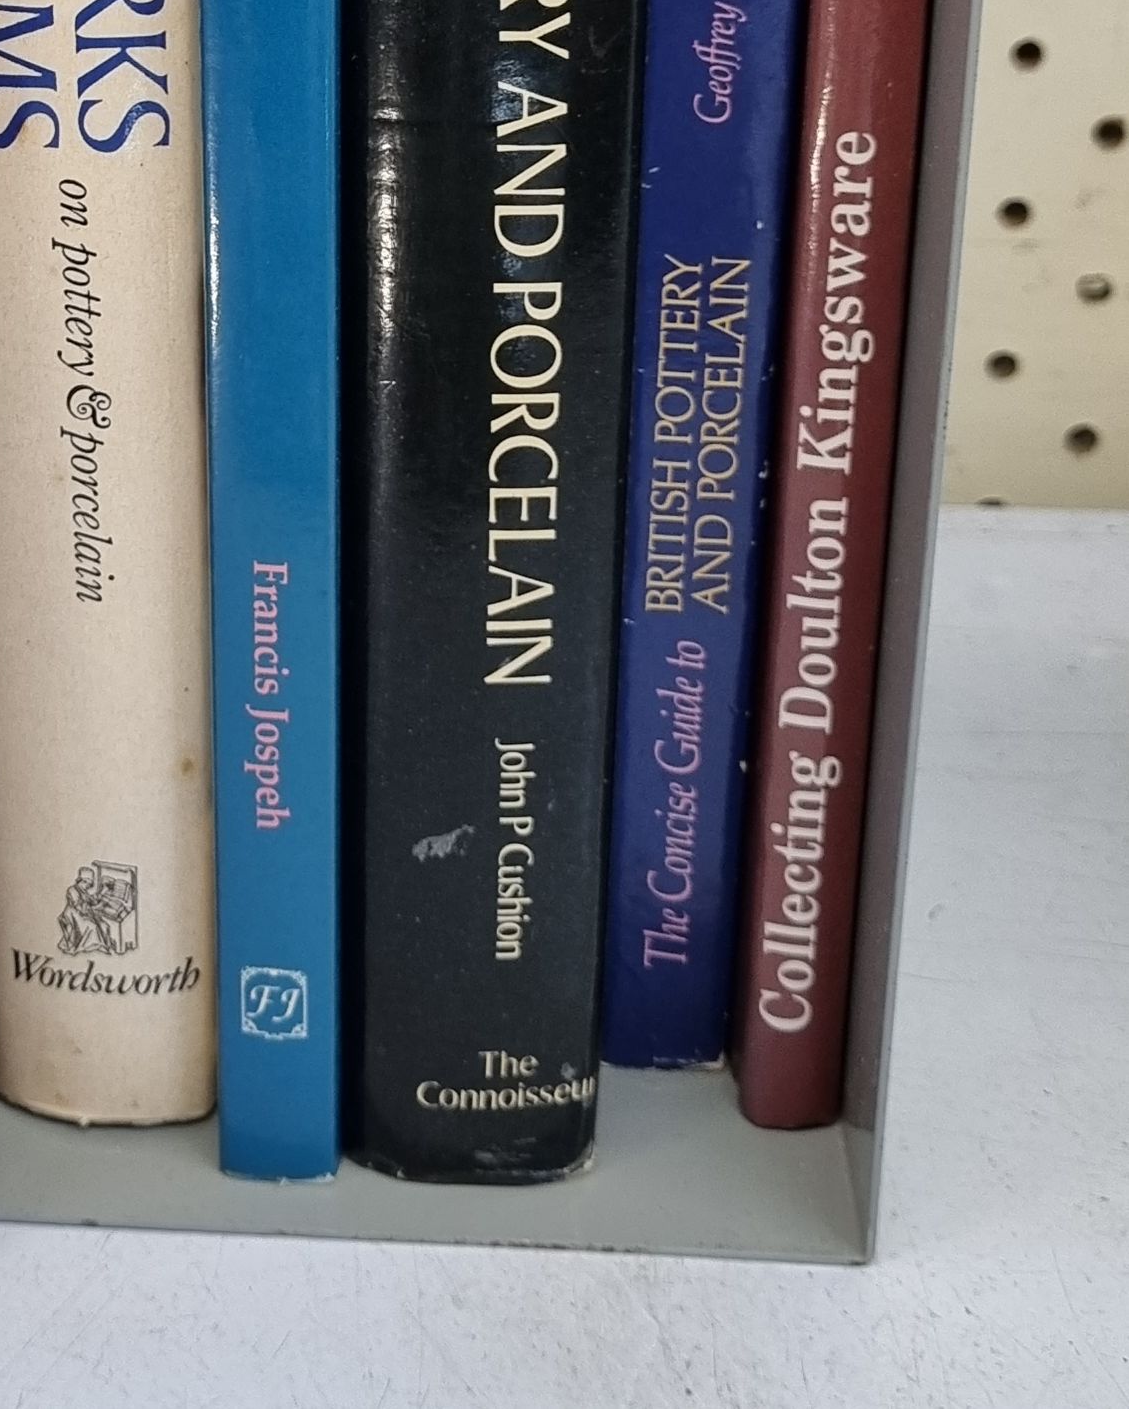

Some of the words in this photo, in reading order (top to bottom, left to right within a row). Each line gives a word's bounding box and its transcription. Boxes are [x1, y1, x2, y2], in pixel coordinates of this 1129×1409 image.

[693, 1, 747, 124] Geoffrey
[58, 178, 88, 228] on
[493, 81, 569, 257] AND
[51, 237, 102, 378] pottery
[654, 253, 703, 444] POTTERY
[796, 130, 878, 476] Kingsware
[66, 384, 112, 430] &
[697, 256, 752, 501] PORCELAIN
[60, 427, 116, 604] porcelain
[484, 282, 563, 684] PORCELAIN
[645, 458, 691, 614] BRITISH
[690, 513, 734, 616] AND
[779, 496, 849, 735] Doulton
[251, 560, 291, 696] Francis
[666, 639, 707, 670] to
[244, 703, 292, 830] Jospeh
[494, 737, 537, 809] John
[654, 676, 705, 775] Guide
[498, 816, 534, 837] P
[647, 781, 699, 903] Concise
[494, 843, 534, 961] Cushion
[643, 907, 691, 969] The
[759, 750, 842, 1034] Collecting
[11, 946, 201, 998] Wordsworth
[478, 1050, 540, 1079] The
